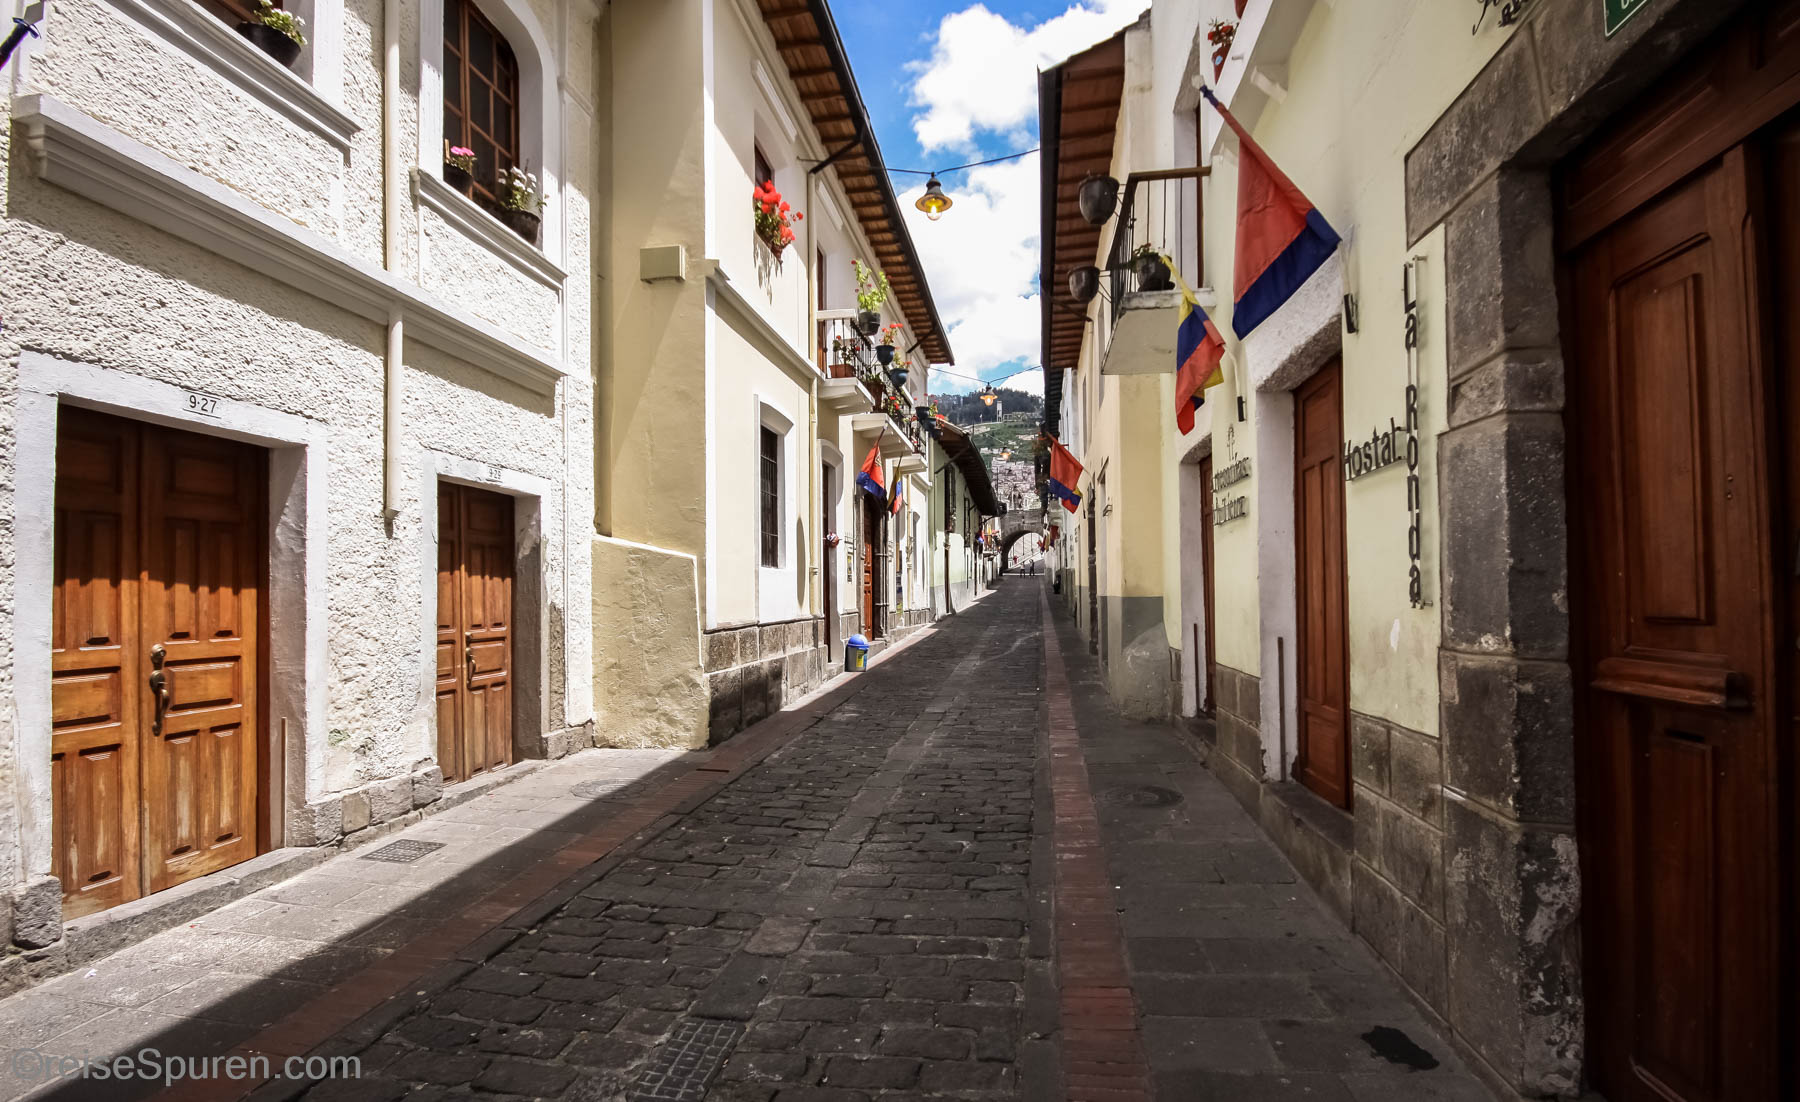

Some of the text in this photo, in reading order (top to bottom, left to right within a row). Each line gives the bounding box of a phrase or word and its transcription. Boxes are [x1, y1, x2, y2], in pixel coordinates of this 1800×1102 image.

[1344, 417, 1396, 481] Hostal
[1404, 264, 1422, 601] La Ronda
